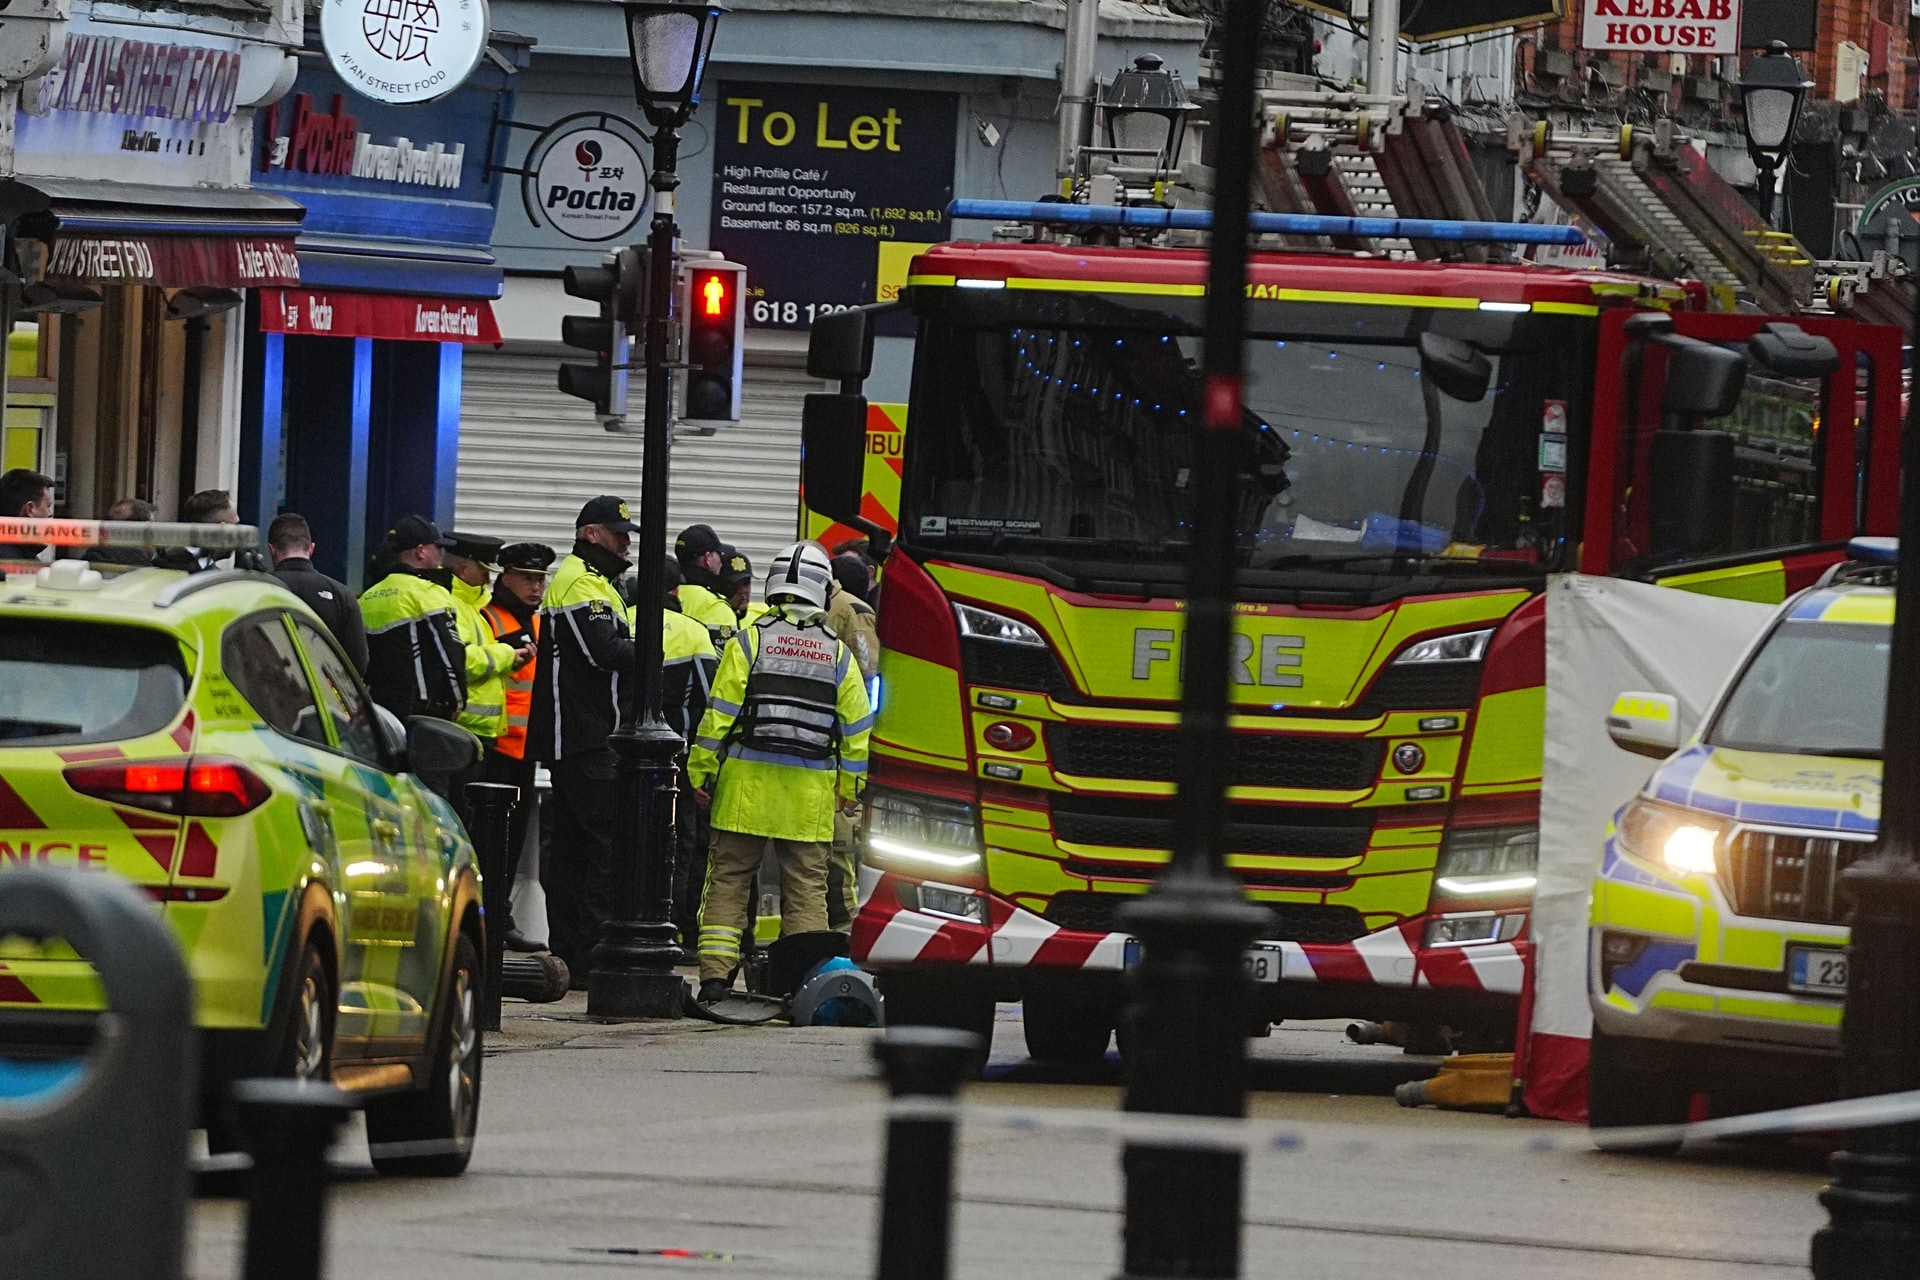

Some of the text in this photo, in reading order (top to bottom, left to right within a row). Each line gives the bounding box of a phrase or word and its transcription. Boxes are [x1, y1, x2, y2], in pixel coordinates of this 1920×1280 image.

[1594, 0, 1732, 20] KEBAB
[1605, 23, 1717, 47] HOUSE
[111, 39, 190, 120] STREET
[181, 49, 241, 123] FOOD
[340, 52, 446, 93] XI'AN STREET FOOD
[285, 93, 355, 176] Pocha
[727, 98, 902, 152] To Let
[599, 167, 624, 181] 포차
[724, 165, 829, 181] High Profile Café /
[547, 185, 636, 211] Pocha
[723, 182, 856, 201] Restaurant Opportunity
[722, 199, 766, 212] Ground
[768, 201, 797, 214] floor:
[801, 203, 833, 216] 157.2
[835, 207, 868, 219] sq.m.
[909, 208, 942, 222] sq.ft.)
[721, 216, 895, 238] Basement: 86 sq.m (926 sq.ft.)
[77, 239, 126, 278] STREET
[236, 242, 247, 278] A
[309, 295, 333, 331] Pocha
[752, 300, 798, 324] 618
[948, 518, 1041, 529] WESTWARD SCANIA
[364, 588, 399, 601] GARDA
[765, 645, 833, 662] COMMANDER
[777, 635, 824, 650] INCIDENT
